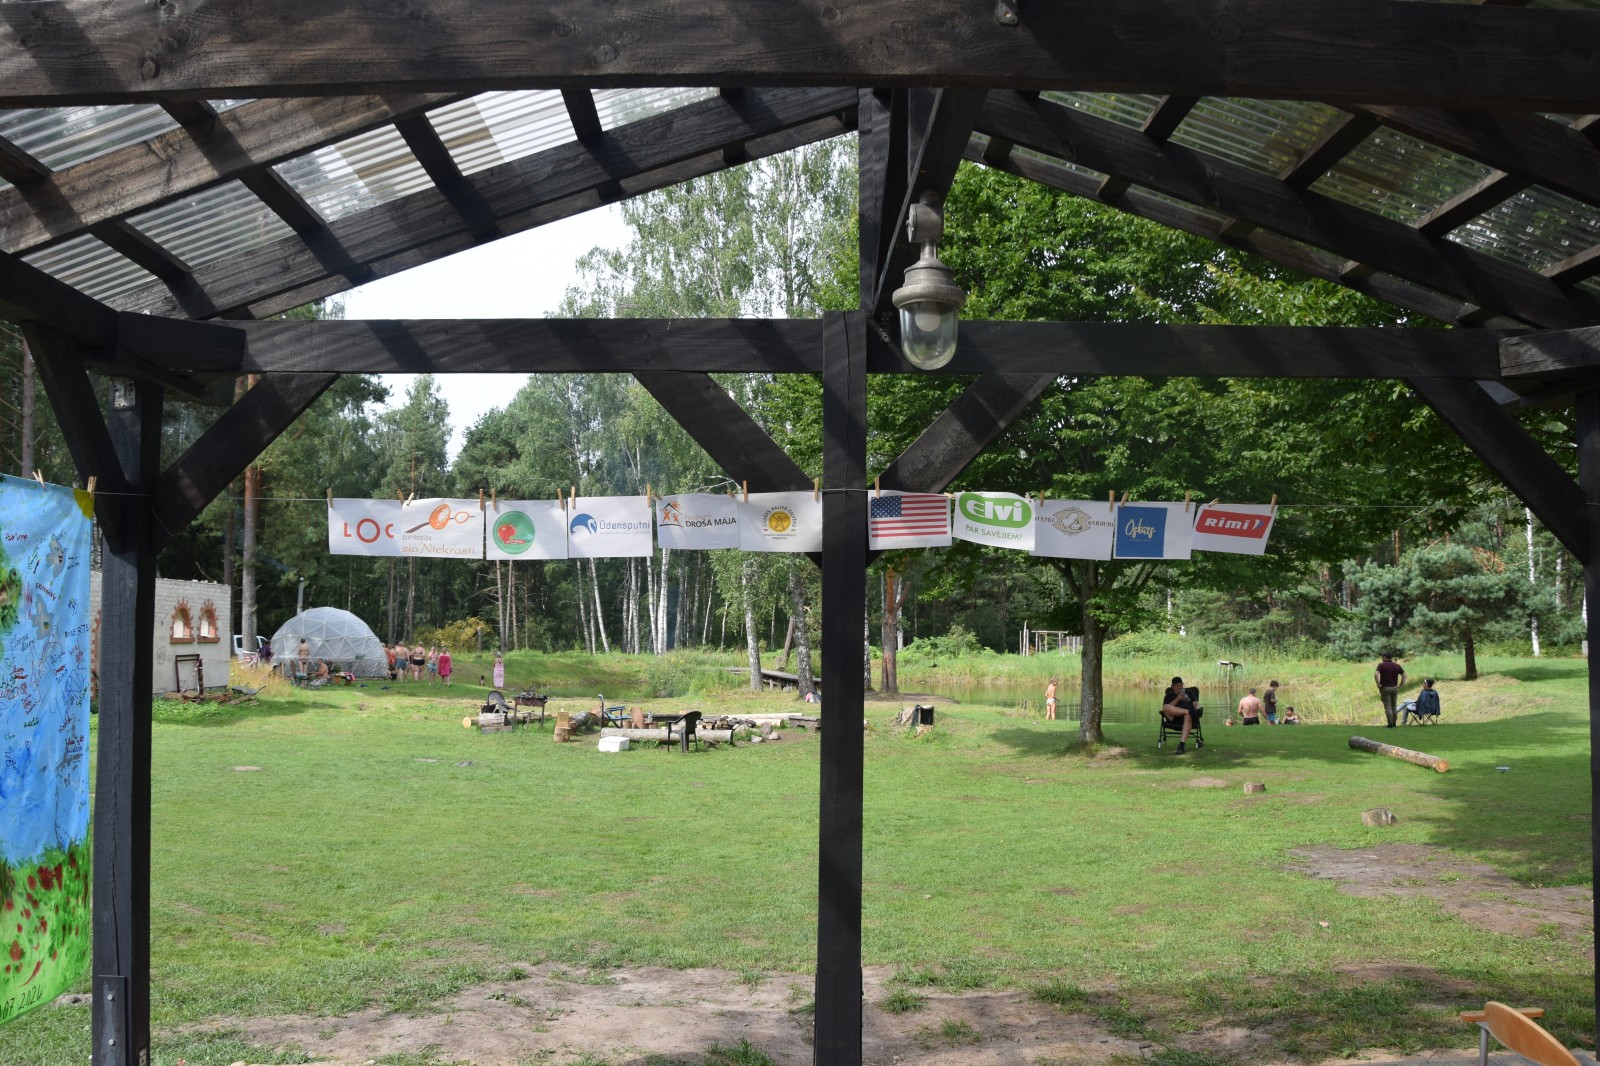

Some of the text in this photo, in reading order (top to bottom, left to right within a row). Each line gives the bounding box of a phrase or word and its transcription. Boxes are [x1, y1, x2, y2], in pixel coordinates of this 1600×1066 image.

[599, 519, 650, 531] Ūdensputni
[714, 516, 737, 526] MĀJA
[1204, 517, 1249, 530] Rimi
[965, 524, 1022, 541] PAR SAVĒJIEM!
[402, 543, 475, 555] sia Nickrasti
